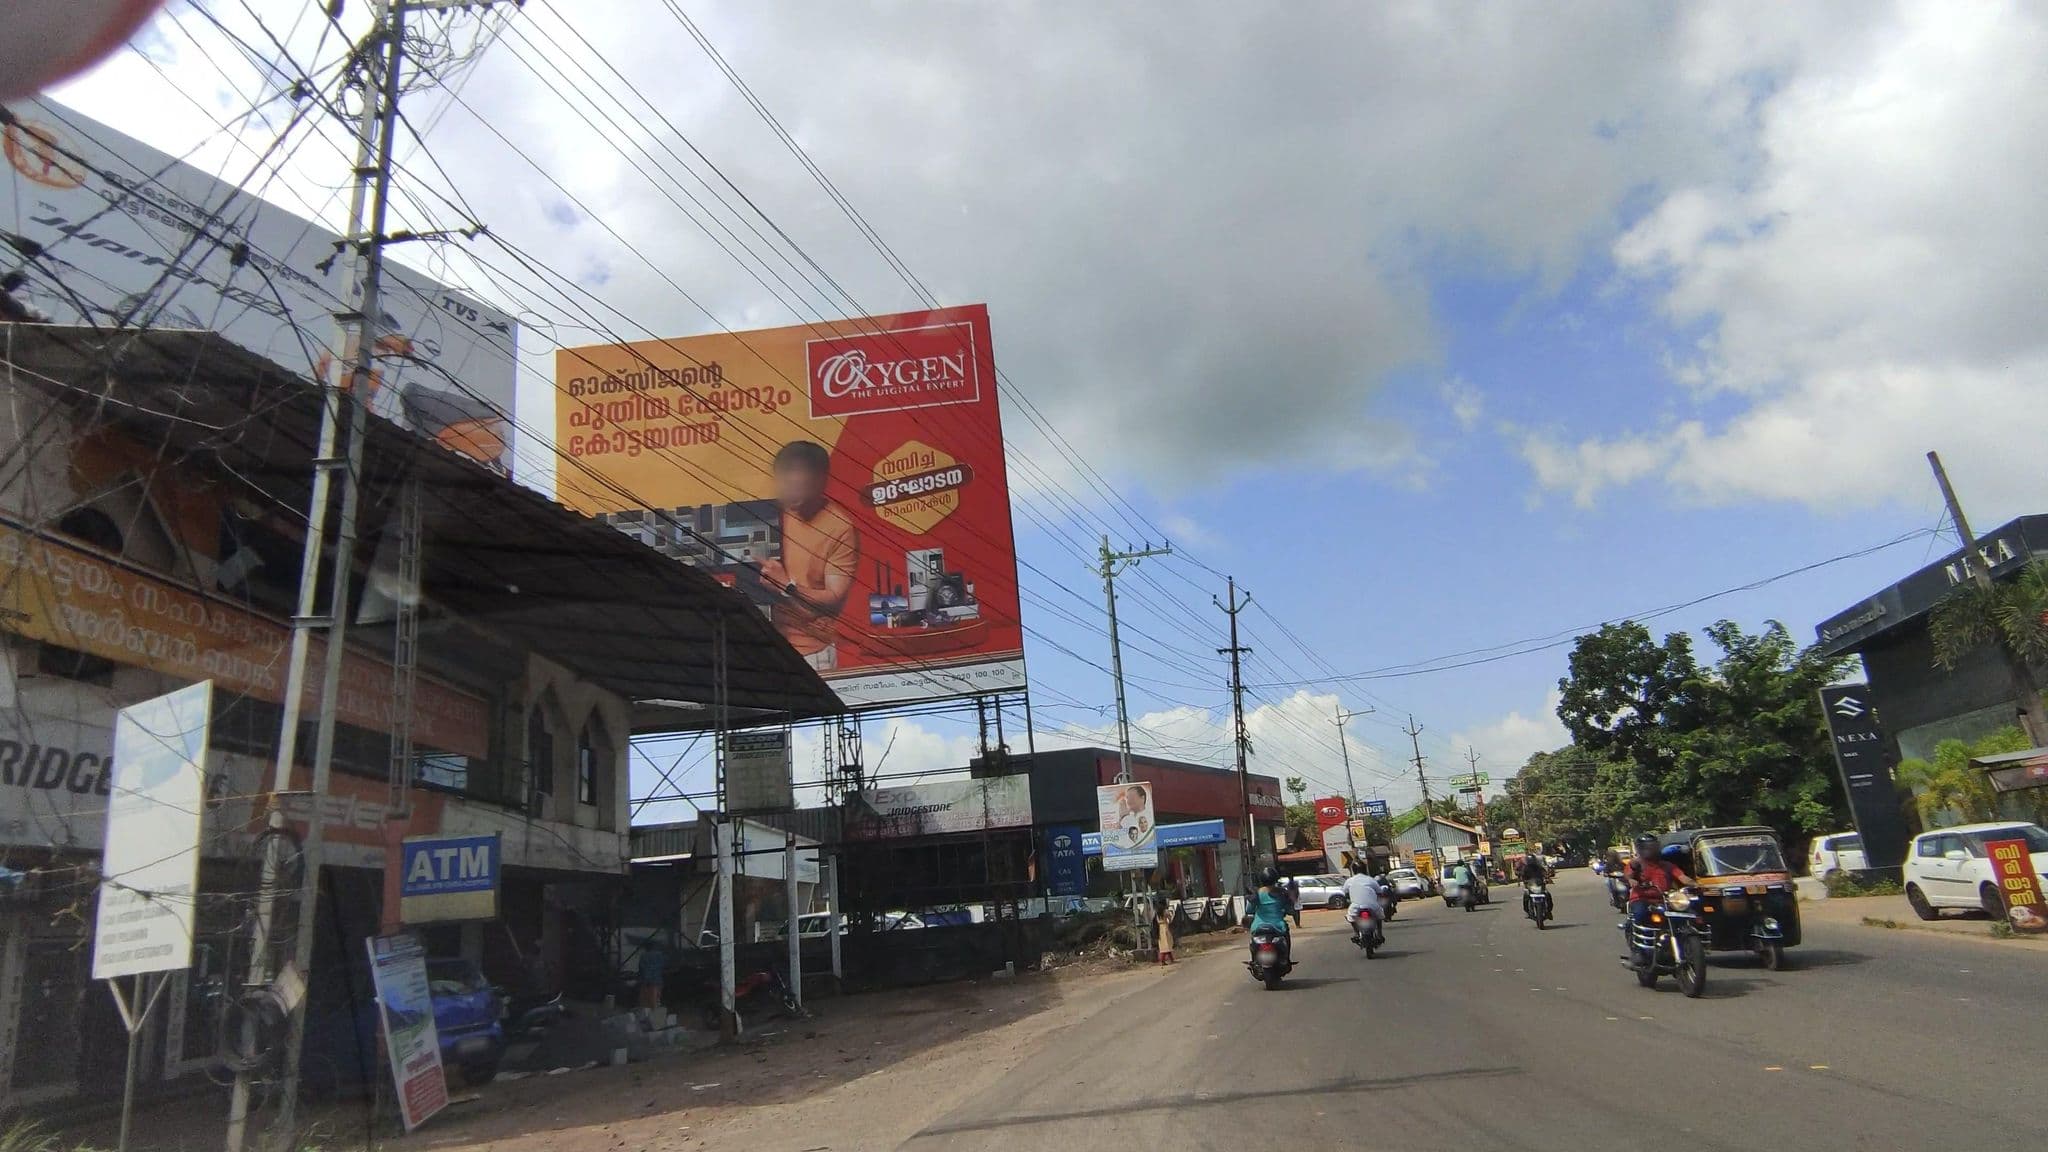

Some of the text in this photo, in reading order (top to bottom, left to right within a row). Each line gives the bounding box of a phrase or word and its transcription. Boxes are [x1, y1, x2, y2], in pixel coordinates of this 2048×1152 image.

[443, 296, 478, 321] TVS
[817, 350, 966, 398] OXYGEN
[852, 379, 965, 399] THE DIGITAL EXPERT
[569, 386, 792, 430] പുതിയ ഷോറൂം
[882, 451, 936, 475] വമ്പിച്ച
[872, 469, 963, 505] ഉദ്ഘാടന
[1945, 538, 2016, 588] NEXA
[1837, 731, 1878, 743] NEXA
[407, 845, 489, 883] ATM
